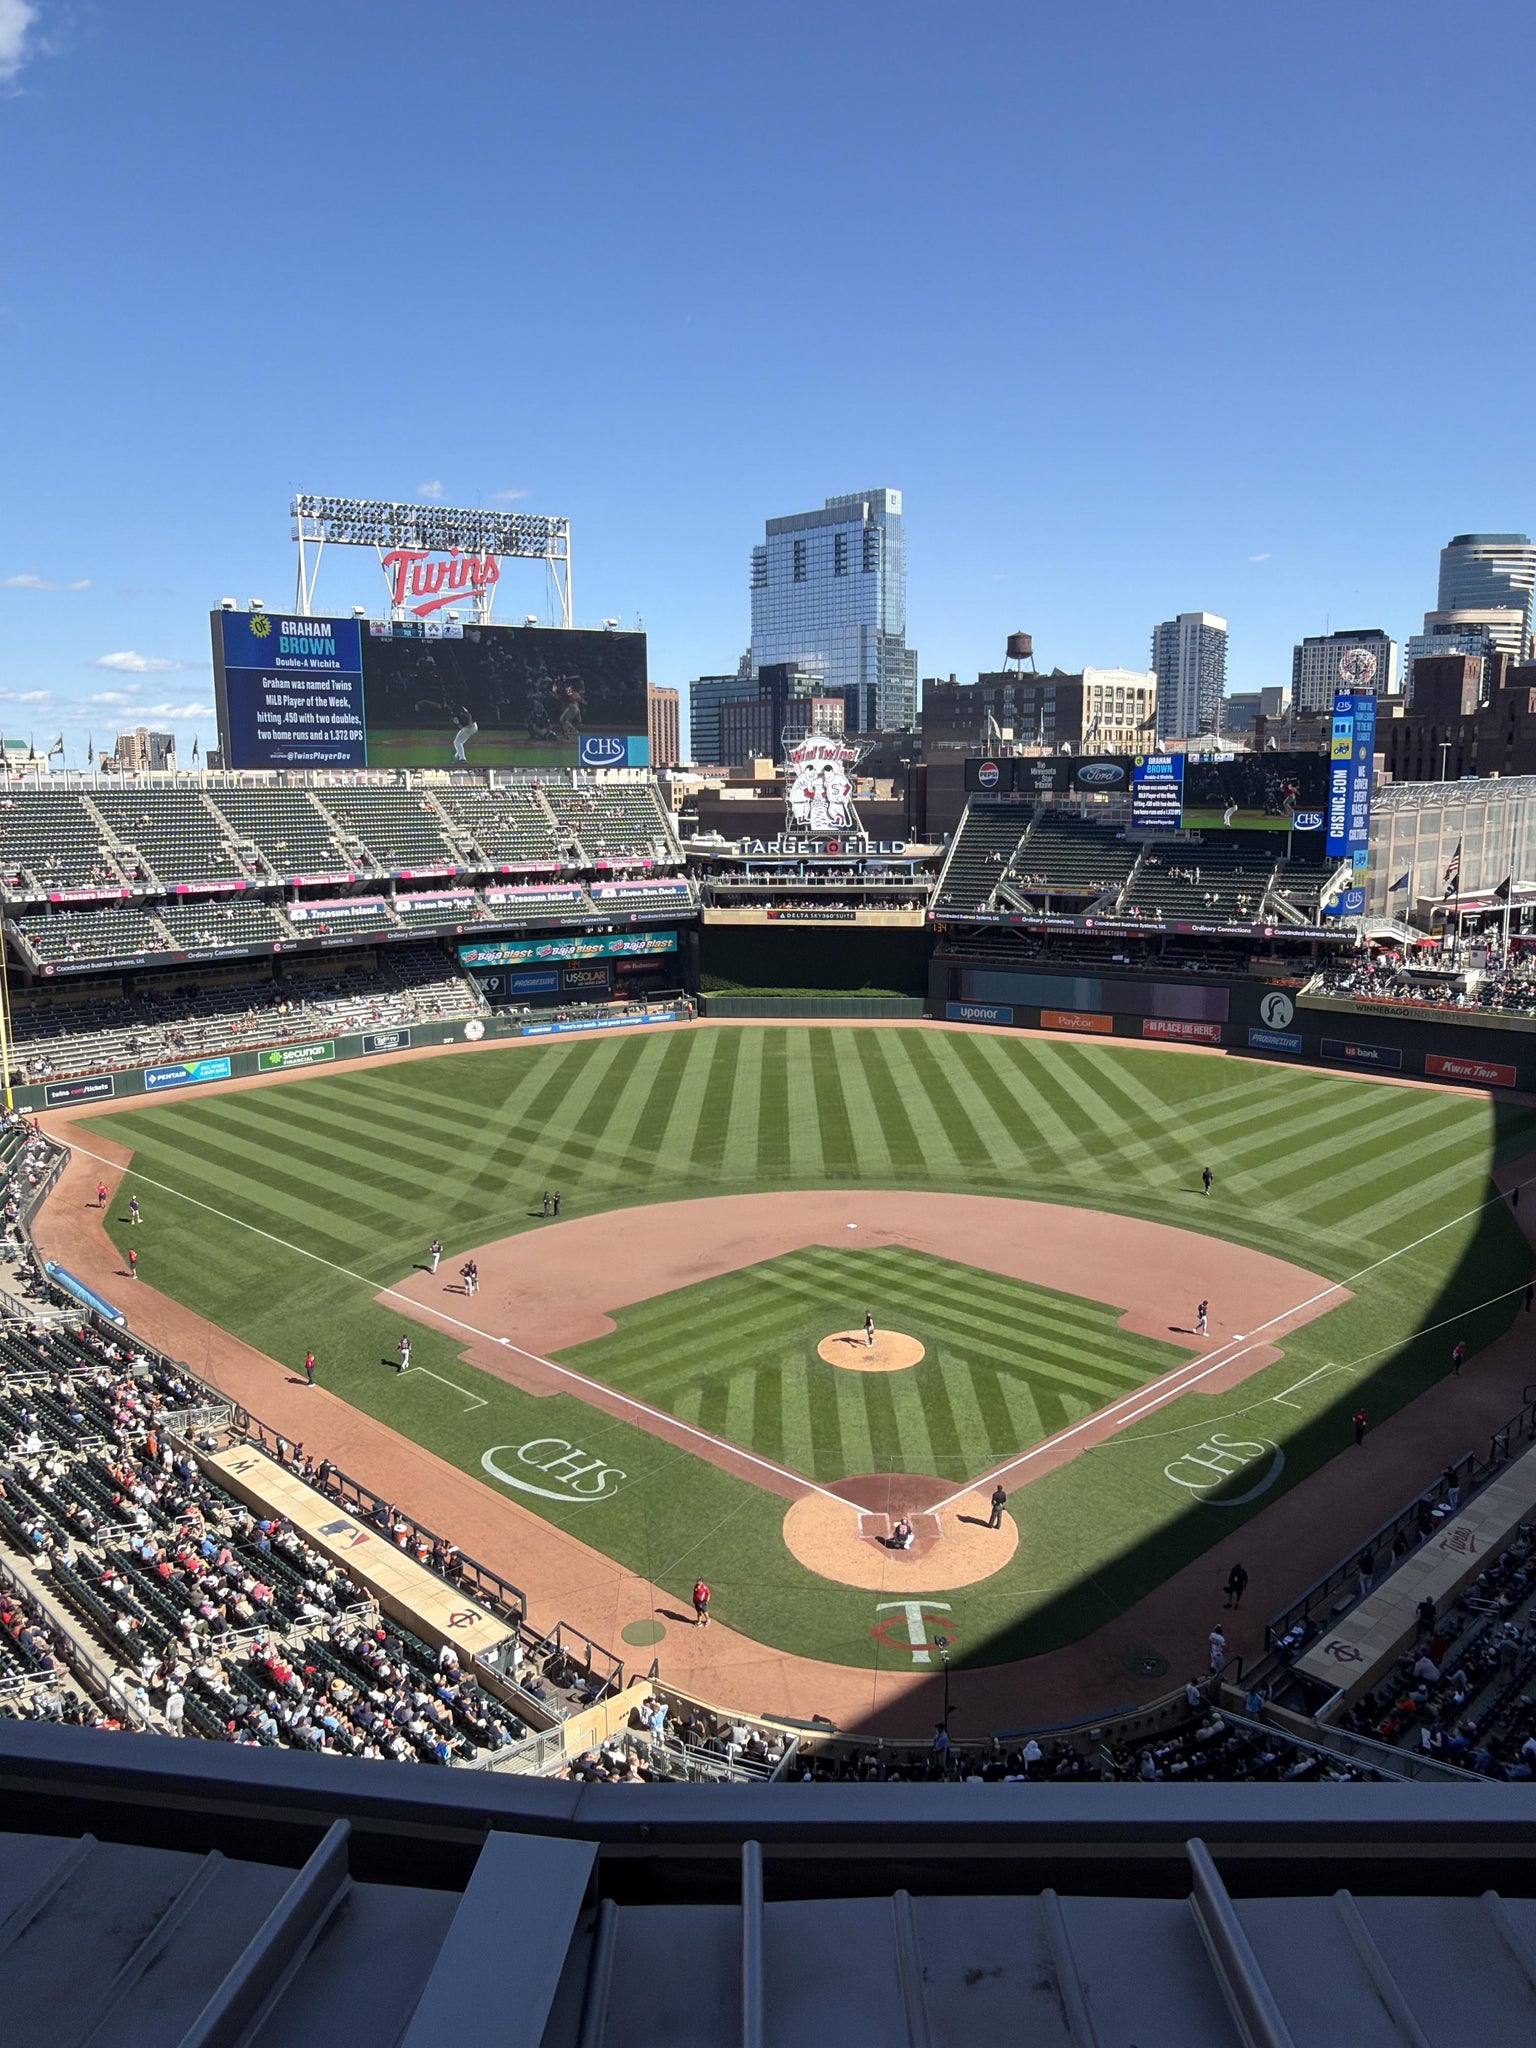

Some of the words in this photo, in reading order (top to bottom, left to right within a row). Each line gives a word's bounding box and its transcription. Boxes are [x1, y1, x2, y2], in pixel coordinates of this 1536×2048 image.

[383, 547, 499, 604] Twins
[281, 621, 332, 637] GRAHAM
[279, 636, 336, 655] BROWN
[275, 657, 309, 667] Double-A
[310, 659, 340, 668] Wichita
[262, 677, 290, 689] Graham
[291, 681, 305, 690] was
[306, 680, 330, 690] named
[331, 680, 352, 691] Twins
[266, 694, 282, 706] MiLB
[283, 695, 305, 708] Player
[306, 696, 314, 706] of
[315, 696, 327, 707] the
[328, 697, 351, 709] Week,
[257, 712, 282, 725] hitting
[298, 713, 314, 723] with
[316, 713, 329, 724] two
[331, 713, 361, 725] doubles,
[258, 729, 271, 740] two
[273, 729, 291, 740] home
[293, 731, 309, 740] runs
[310, 730, 323, 740] and
[324, 732, 329, 740] a
[349, 730, 363, 741] OPS
[586, 738, 621, 755] CHS
[287, 752, 351, 760] @TwinsPlayerDev
[1030, 767, 1056, 775] Minnesota
[1087, 767, 1114, 781] Ford
[1147, 765, 1172, 773] BROWN
[1358, 766, 1366, 777] WE
[1354, 791, 1367, 803] EVERY
[1330, 769, 1348, 838] CHSINC.COM
[1298, 814, 1319, 824] CHS
[741, 841, 824, 854] TARGET
[845, 841, 906, 854] FIELD
[300, 877, 329, 885] Treasure
[329, 875, 350, 883] Island
[60, 892, 97, 901] Treasure
[97, 890, 122, 899] Island
[510, 895, 546, 903] Treasure
[547, 892, 573, 900] Island
[1348, 892, 1362, 903] CHS
[351, 906, 377, 916] Island
[1044, 917, 1074, 925] Connections
[409, 929, 437, 938] Connections
[1217, 925, 1252, 934] Connections
[552, 946, 575, 956] Baja
[575, 944, 604, 953] Blast
[623, 941, 646, 951] Baja
[646, 940, 674, 948] Blast
[214, 948, 249, 957] Connections
[478, 951, 503, 961] Baja
[503, 949, 533, 958] Blast
[56, 963, 90, 972] Coordinated
[91, 961, 113, 970] Business
[514, 978, 555, 987] PROGRESSIVE
[960, 1007, 997, 1019] uponor
[1356, 1004, 1409, 1017] WINNEBAGO
[1410, 1010, 1468, 1023] INDUSTRIES
[1059, 1016, 1093, 1028] Paycor
[1158, 1023, 1182, 1033] PLACE
[1182, 1025, 1193, 1034] LIKE
[1194, 1026, 1213, 1035] HERE
[1252, 1034, 1299, 1047] PROGRESSIVE
[283, 1057, 314, 1066] FINANCIAL
[157, 1071, 187, 1081] PENTAIR
[517, 1438, 627, 1493] CHS
[1164, 1433, 1265, 1488] CHS
[1439, 1526, 1473, 1555] Twins
